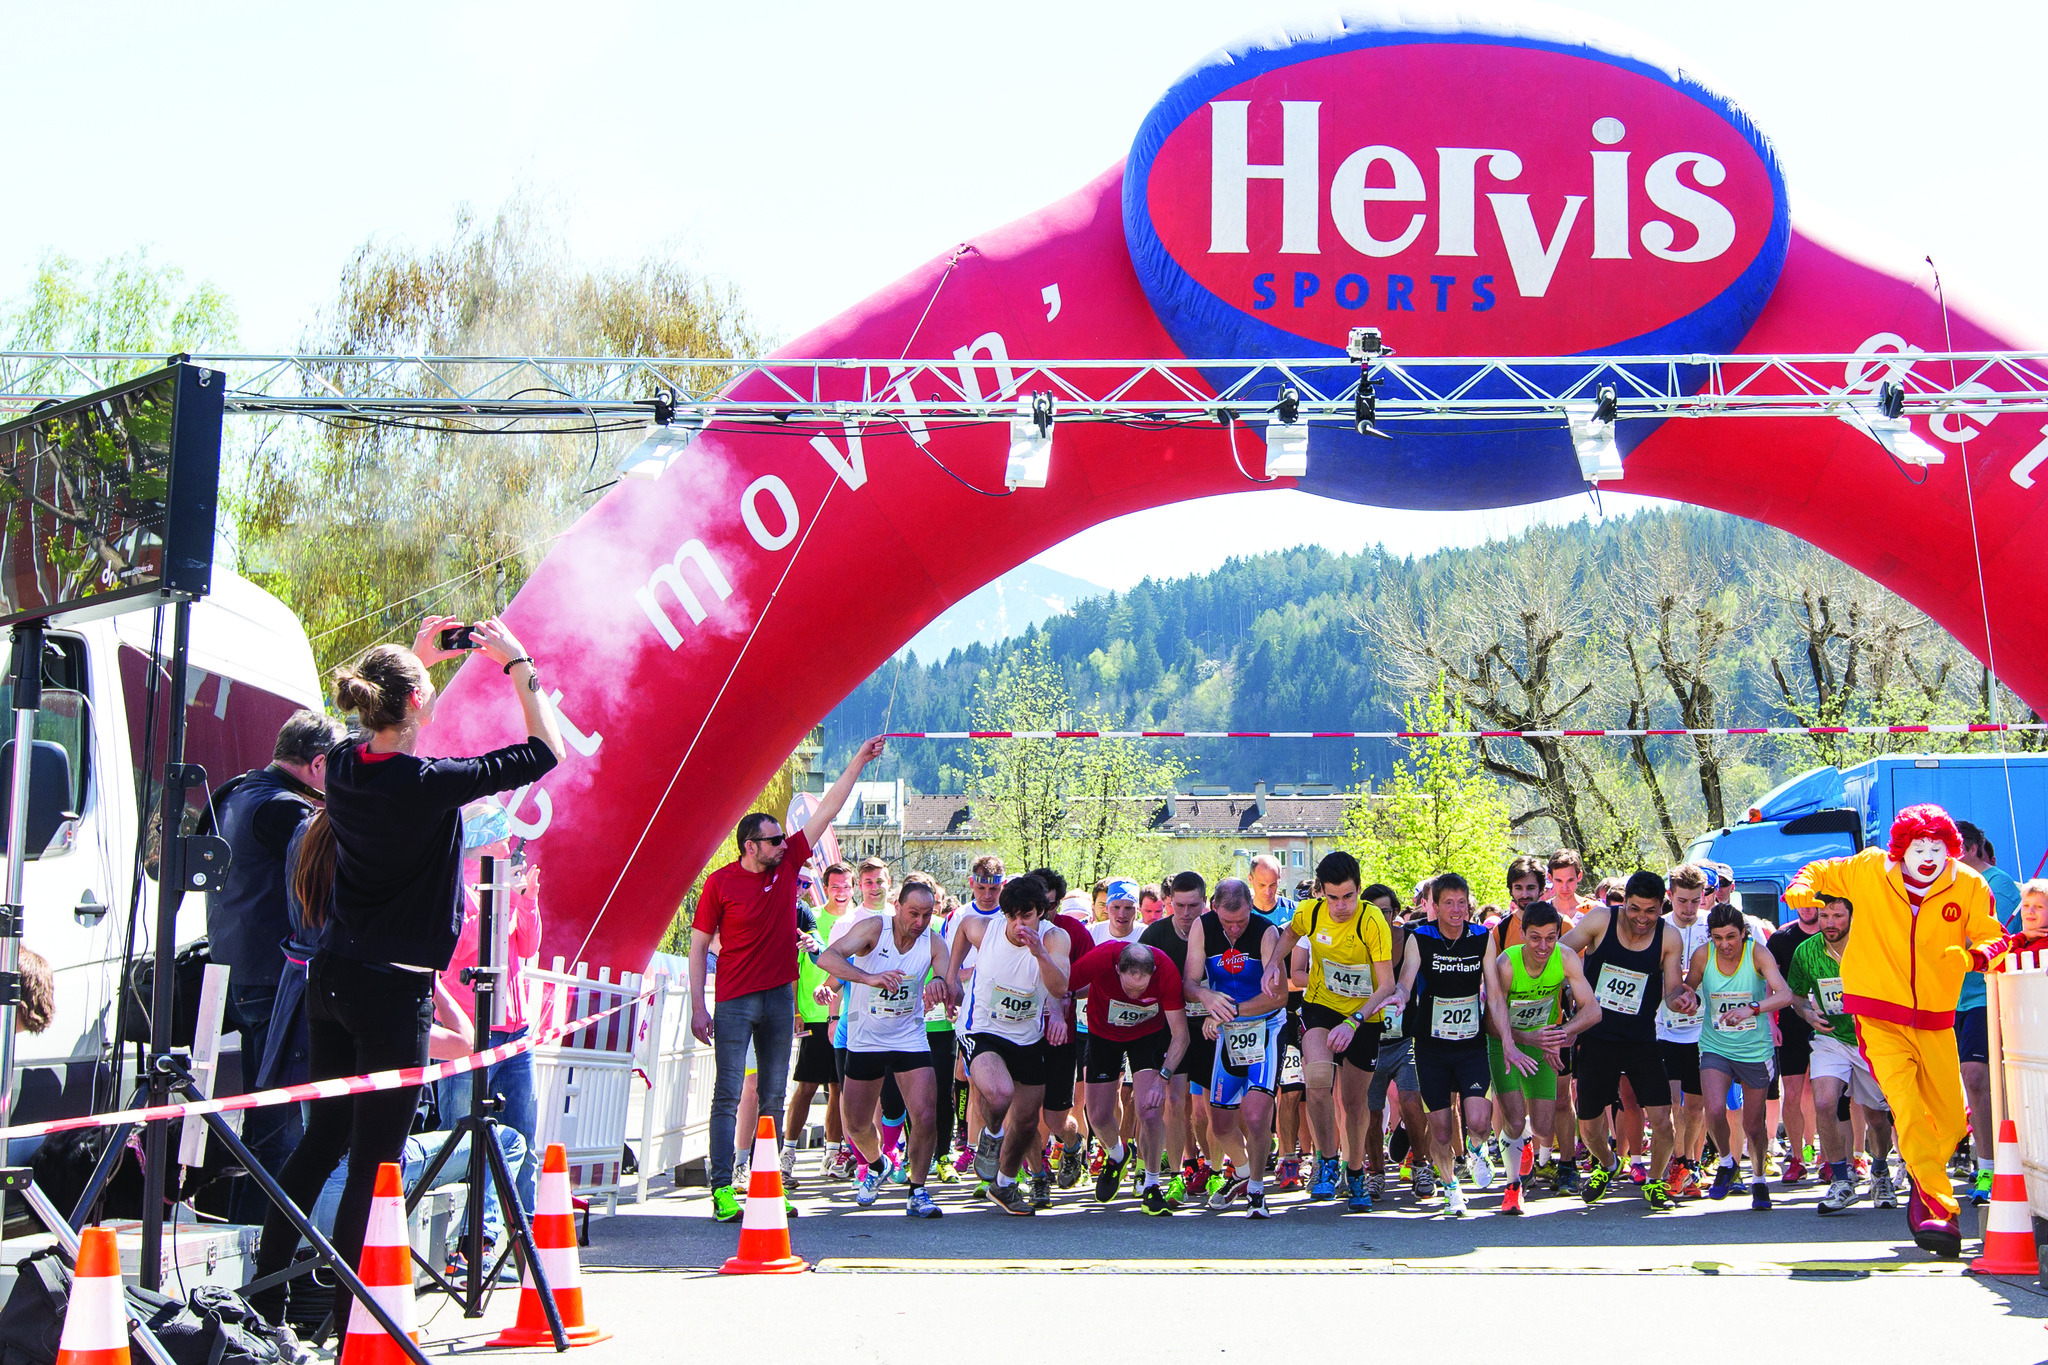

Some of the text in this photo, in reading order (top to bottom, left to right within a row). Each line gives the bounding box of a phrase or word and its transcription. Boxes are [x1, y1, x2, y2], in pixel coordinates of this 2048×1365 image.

[1207, 100, 1737, 298] Hervis
[1253, 271, 1498, 313] SPORTS
[1432, 961, 1481, 973] Sportland
[1333, 971, 1361, 986] 447
[879, 985, 909, 1001] 425
[1606, 977, 1636, 998] 492
[1000, 996, 1032, 1012] 409
[1442, 1008, 1472, 1025] 202
[1229, 1032, 1258, 1051] 299
[1284, 1055, 1302, 1069] 28
